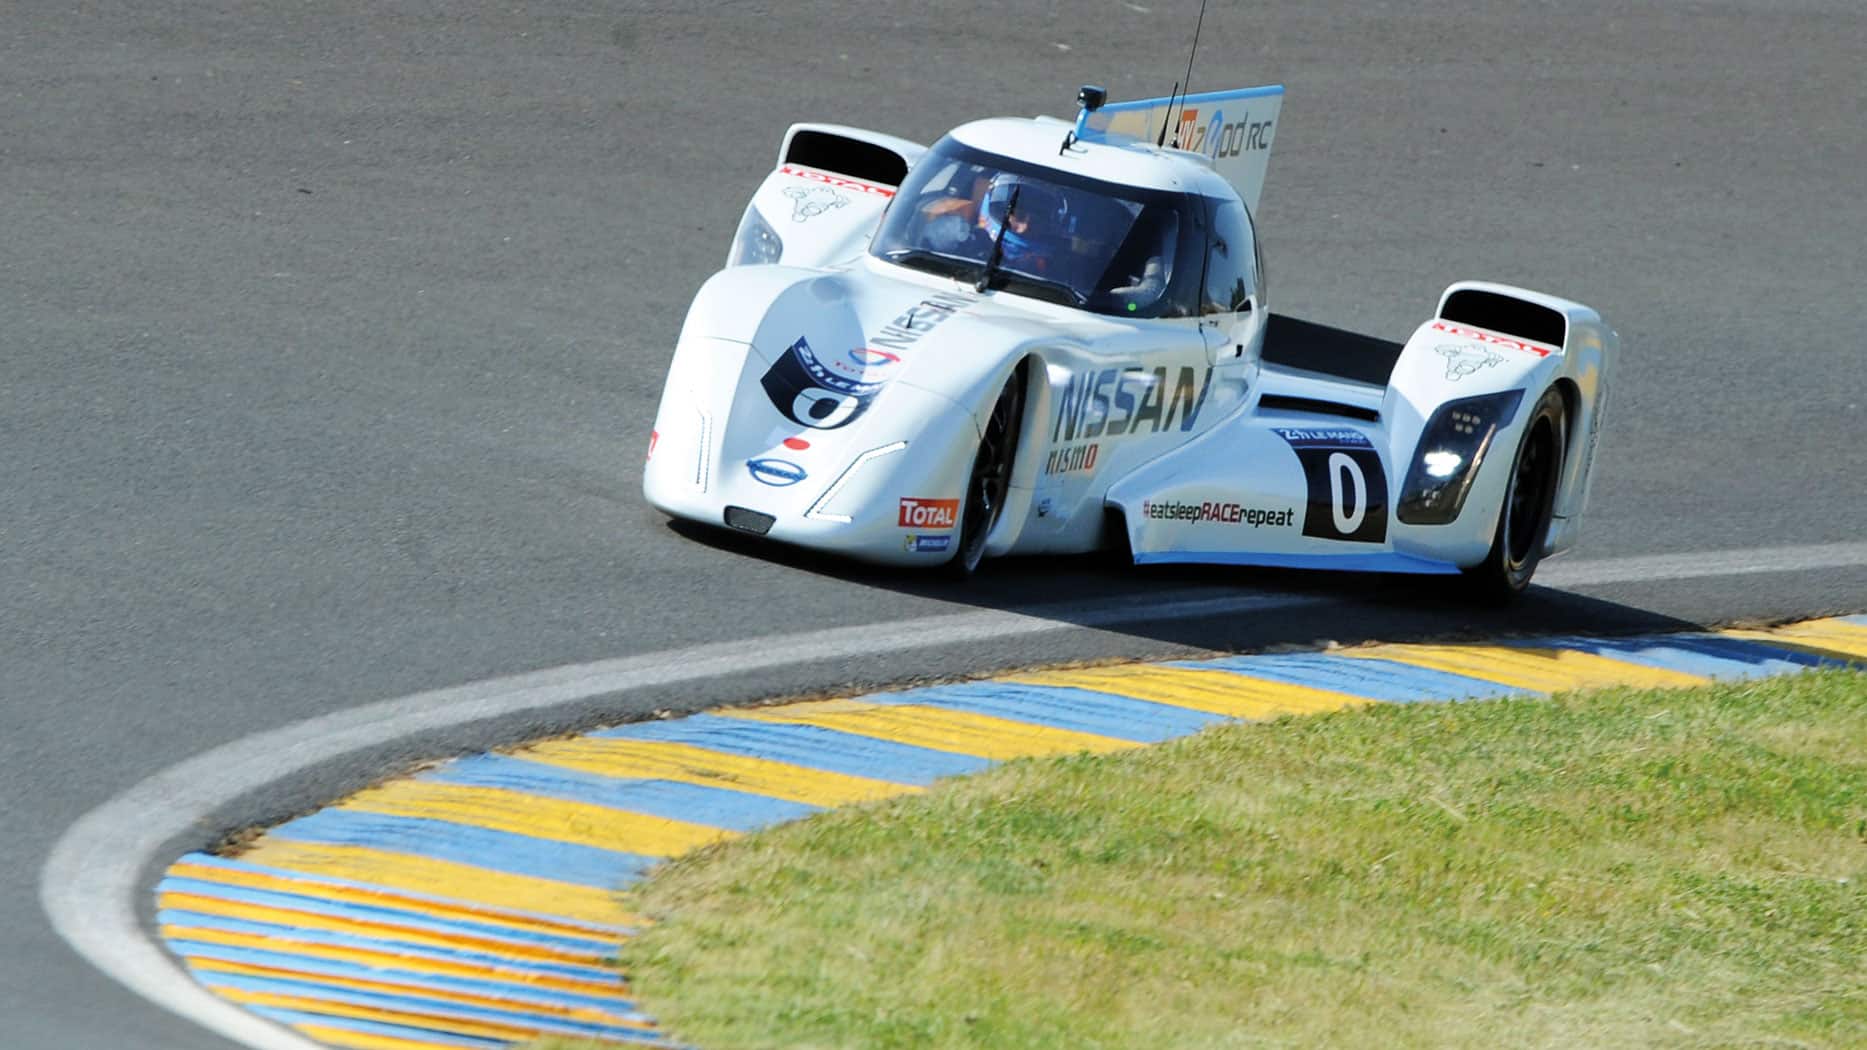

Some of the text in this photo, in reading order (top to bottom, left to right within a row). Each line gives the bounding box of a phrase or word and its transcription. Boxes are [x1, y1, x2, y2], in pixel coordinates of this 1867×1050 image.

[1246, 121, 1272, 151] RC
[870, 290, 979, 351] NISSAN
[1432, 322, 1552, 357] TOTAL
[792, 387, 859, 428] 0
[1053, 366, 1213, 443] NISSAN
[1329, 452, 1367, 534] 0
[1143, 500, 1294, 528] #eatsleepRACErepeat
